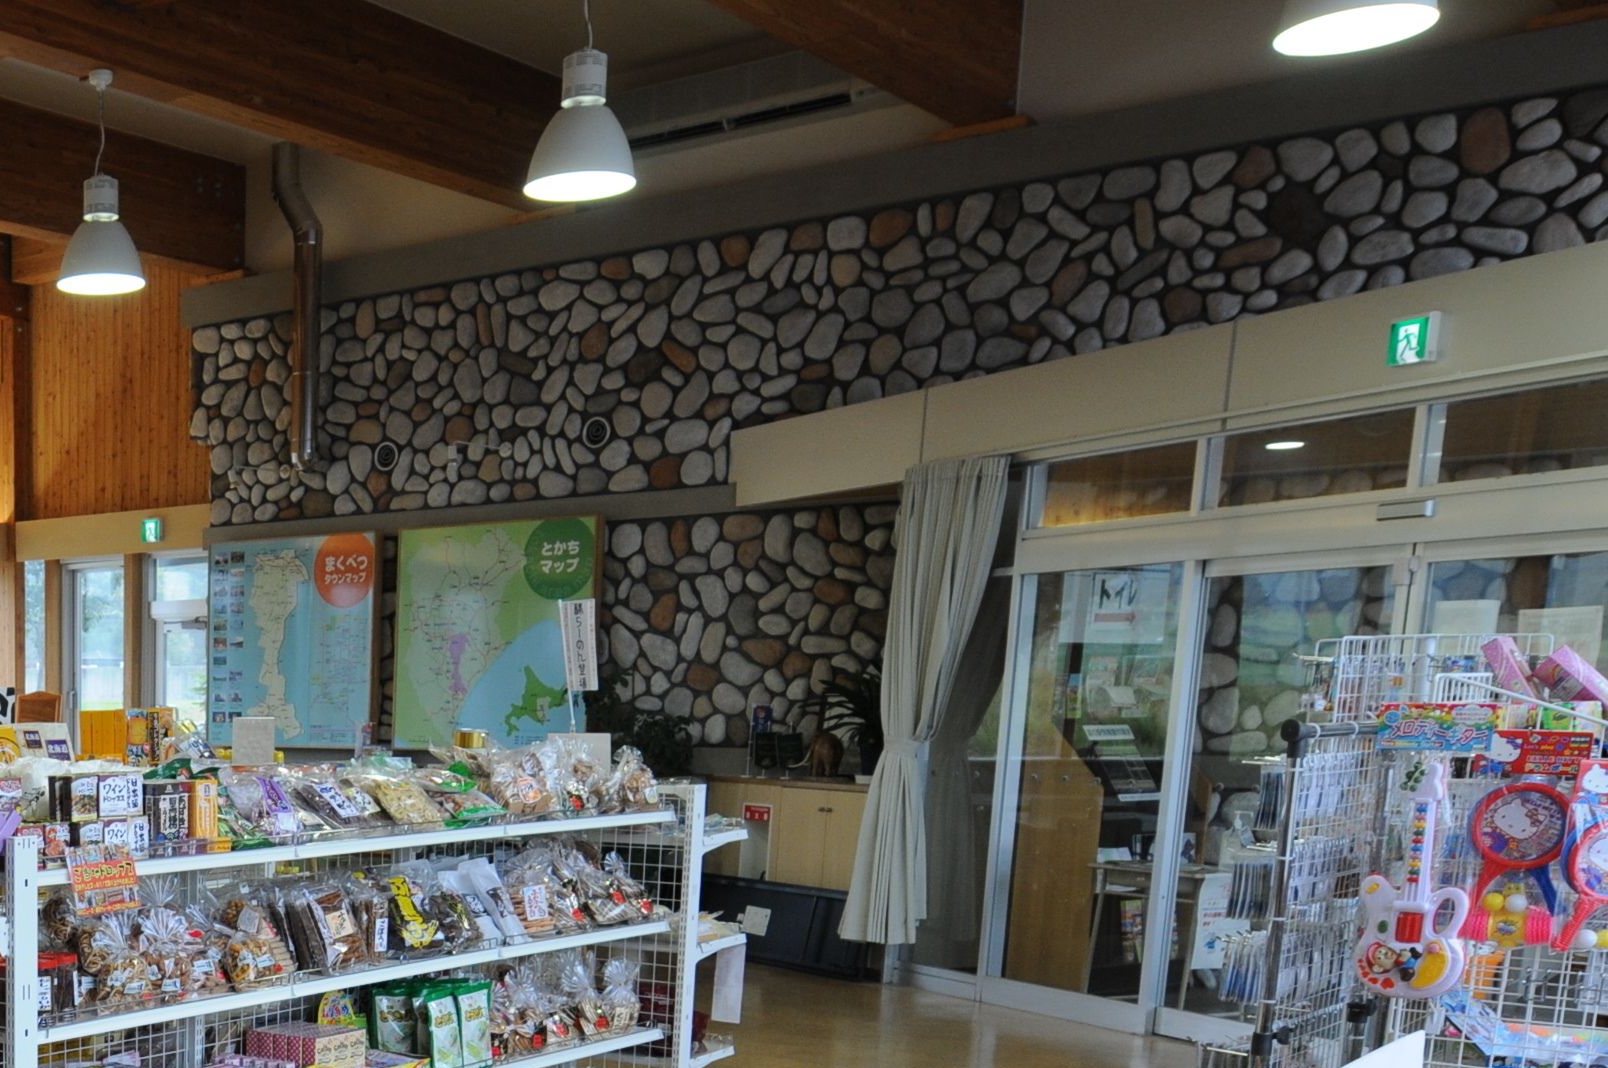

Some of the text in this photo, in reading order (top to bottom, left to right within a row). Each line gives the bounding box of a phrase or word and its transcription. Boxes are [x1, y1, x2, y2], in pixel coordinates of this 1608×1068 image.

[541, 540, 580, 556] とかち
[324, 555, 368, 572] まくべつ
[540, 557, 580, 574] マップ
[324, 571, 368, 585] タウンマップ
[1098, 578, 1139, 610] トイレ
[102, 782, 127, 796] ワイン
[107, 826, 127, 840] ワイン
